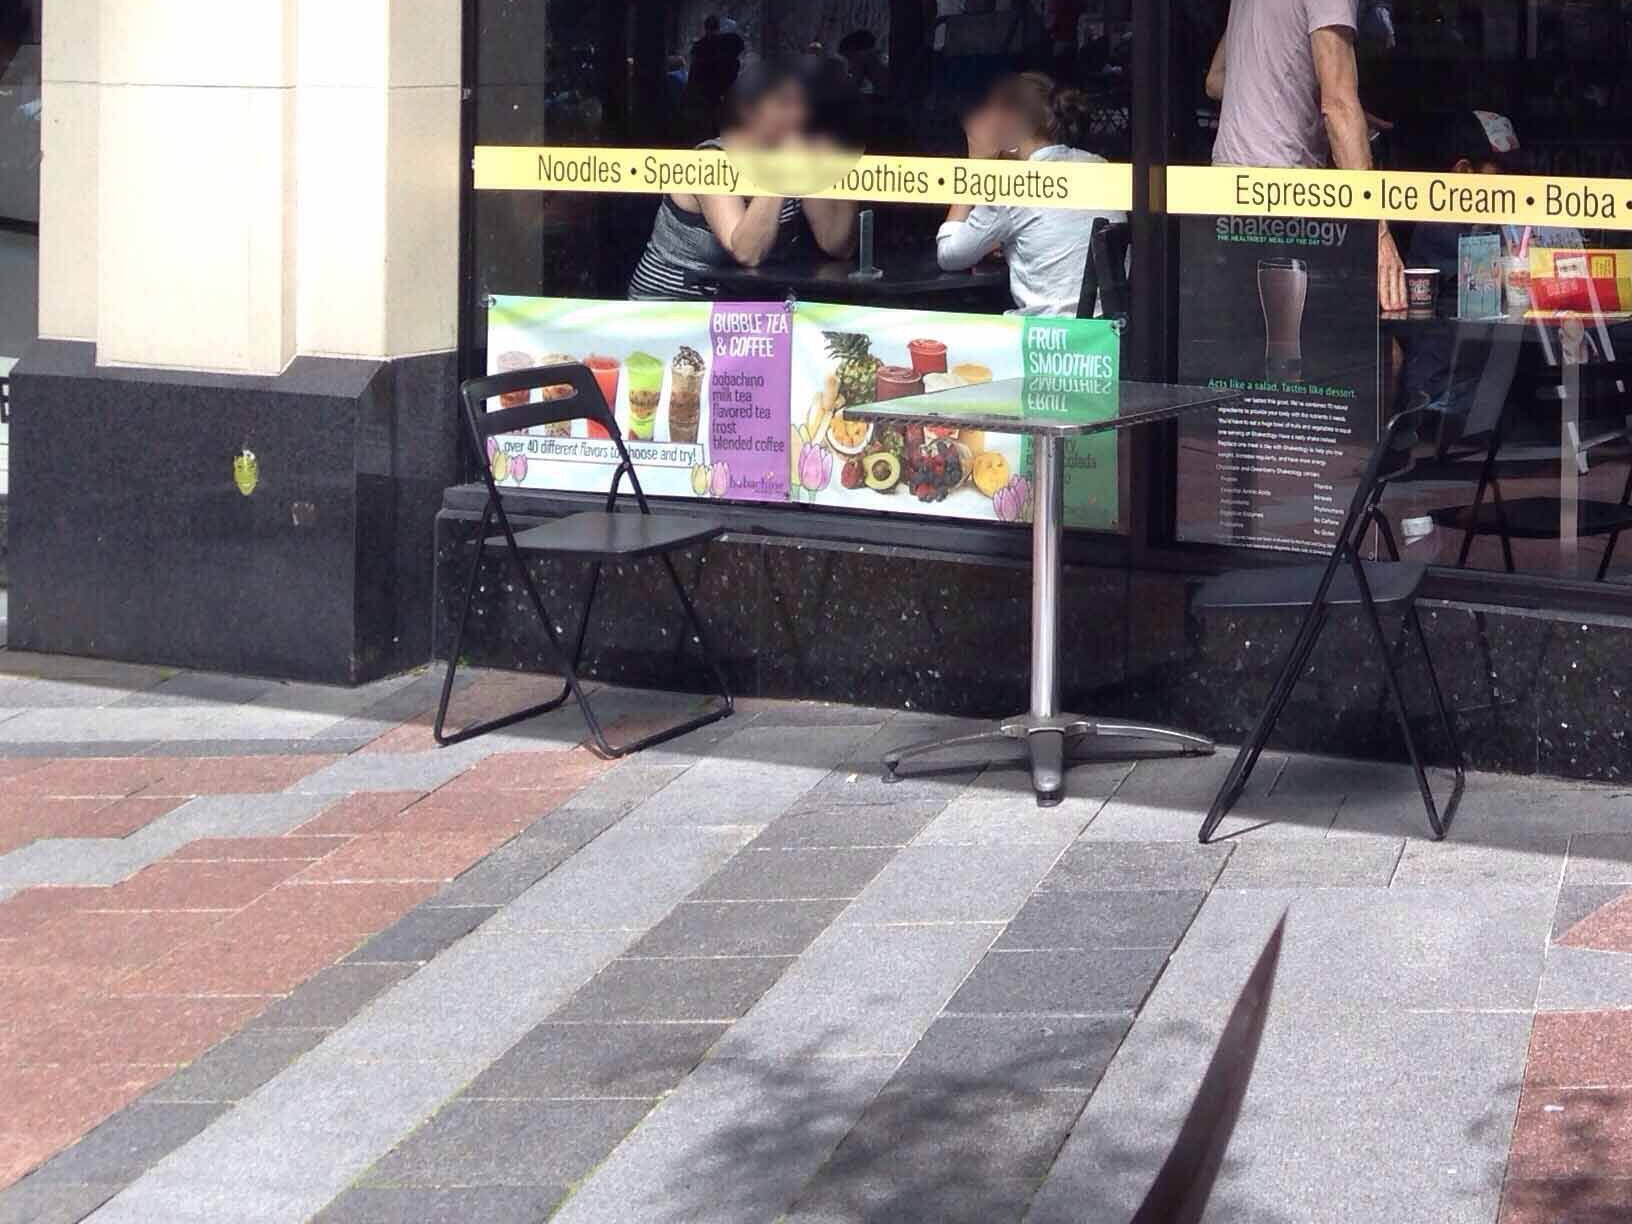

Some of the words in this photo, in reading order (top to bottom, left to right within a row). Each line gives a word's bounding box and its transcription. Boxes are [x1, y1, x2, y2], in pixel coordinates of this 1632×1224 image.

[537, 154, 622, 185] Noodles
[643, 156, 740, 193] Specialty
[953, 166, 1069, 203] Baguettes
[1235, 174, 1353, 212] Espresso
[1380, 178, 1419, 212] Ice
[1428, 179, 1517, 216] Cream
[1546, 183, 1617, 219] Boba
[1216, 216, 1348, 247] shakeology
[713, 313, 763, 333] BUBBLE
[765, 313, 788, 334] TEA
[716, 336, 727, 357] &
[729, 336, 775, 357] COFFEE
[1027, 326, 1069, 351] FRUIT
[1029, 351, 1113, 378] SMOOTHIES
[712, 387, 732, 402] milk
[735, 389, 752, 402] tea
[1208, 378, 1228, 389] Acts
[1230, 378, 1244, 390] like
[1282, 383, 1307, 394] Tastes
[1309, 384, 1324, 395] like
[712, 403, 753, 418] flavored
[755, 406, 771, 419] tea
[712, 419, 737, 434] frost
[527, 440, 538, 453] 40
[540, 440, 578, 456] different
[580, 442, 609, 458] flavors
[628, 447, 658, 461] hoose
[660, 448, 677, 462] and
[679, 449, 696, 465] try!
[712, 435, 753, 450] blended
[754, 436, 785, 452] coffee
